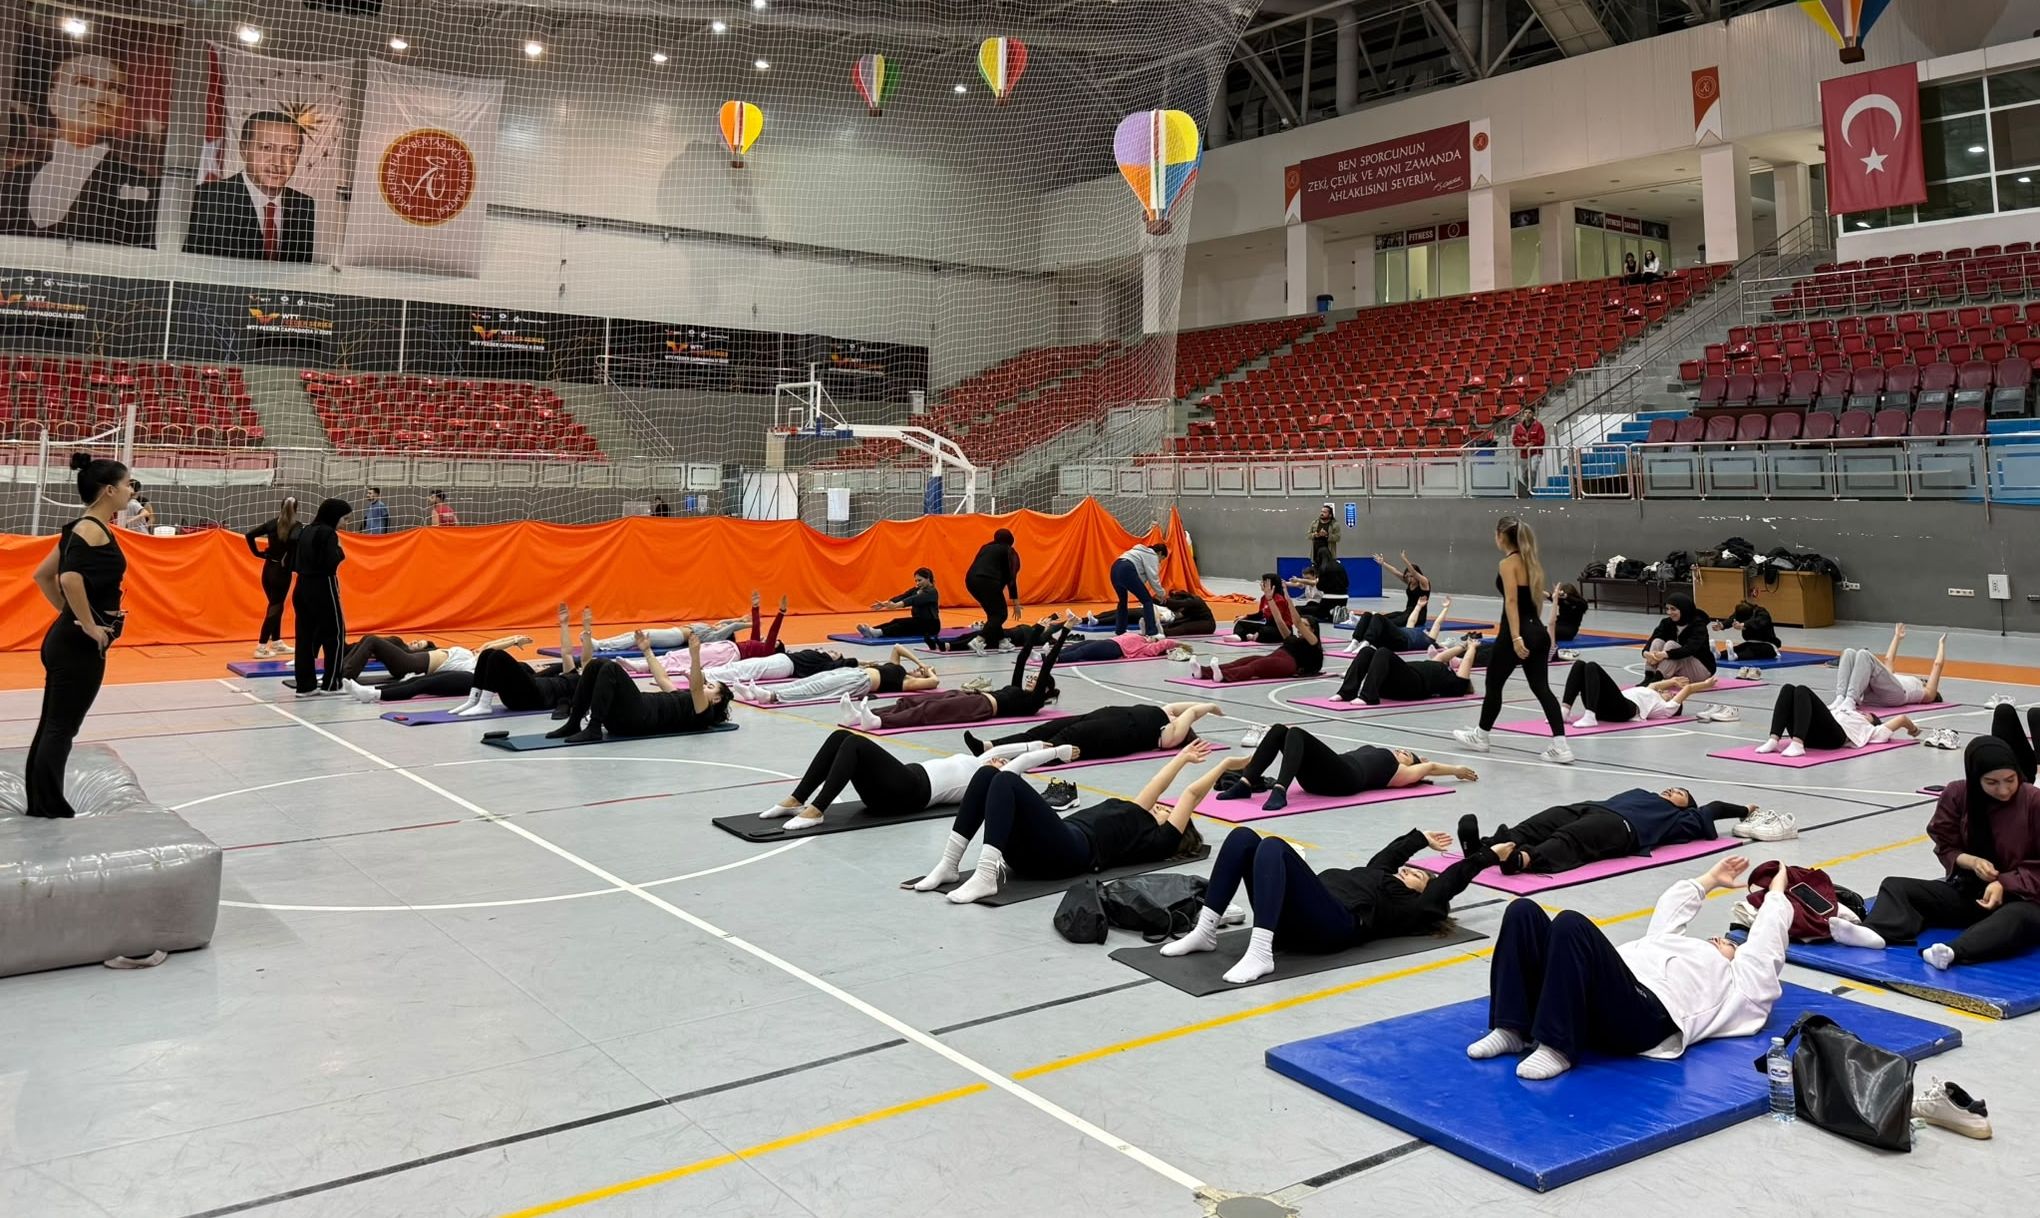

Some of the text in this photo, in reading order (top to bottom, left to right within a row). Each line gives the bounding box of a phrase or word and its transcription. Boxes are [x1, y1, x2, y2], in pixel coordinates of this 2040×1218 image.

[1330, 172, 1358, 189] ÇEVİK
[1361, 169, 1373, 181] VE
[1376, 163, 1401, 179] AYNI
[1405, 149, 1462, 172] ZAMANDA
[1338, 142, 1425, 172] BEN SPORCUNUN
[1328, 181, 1388, 203] AHLAKLISINI
